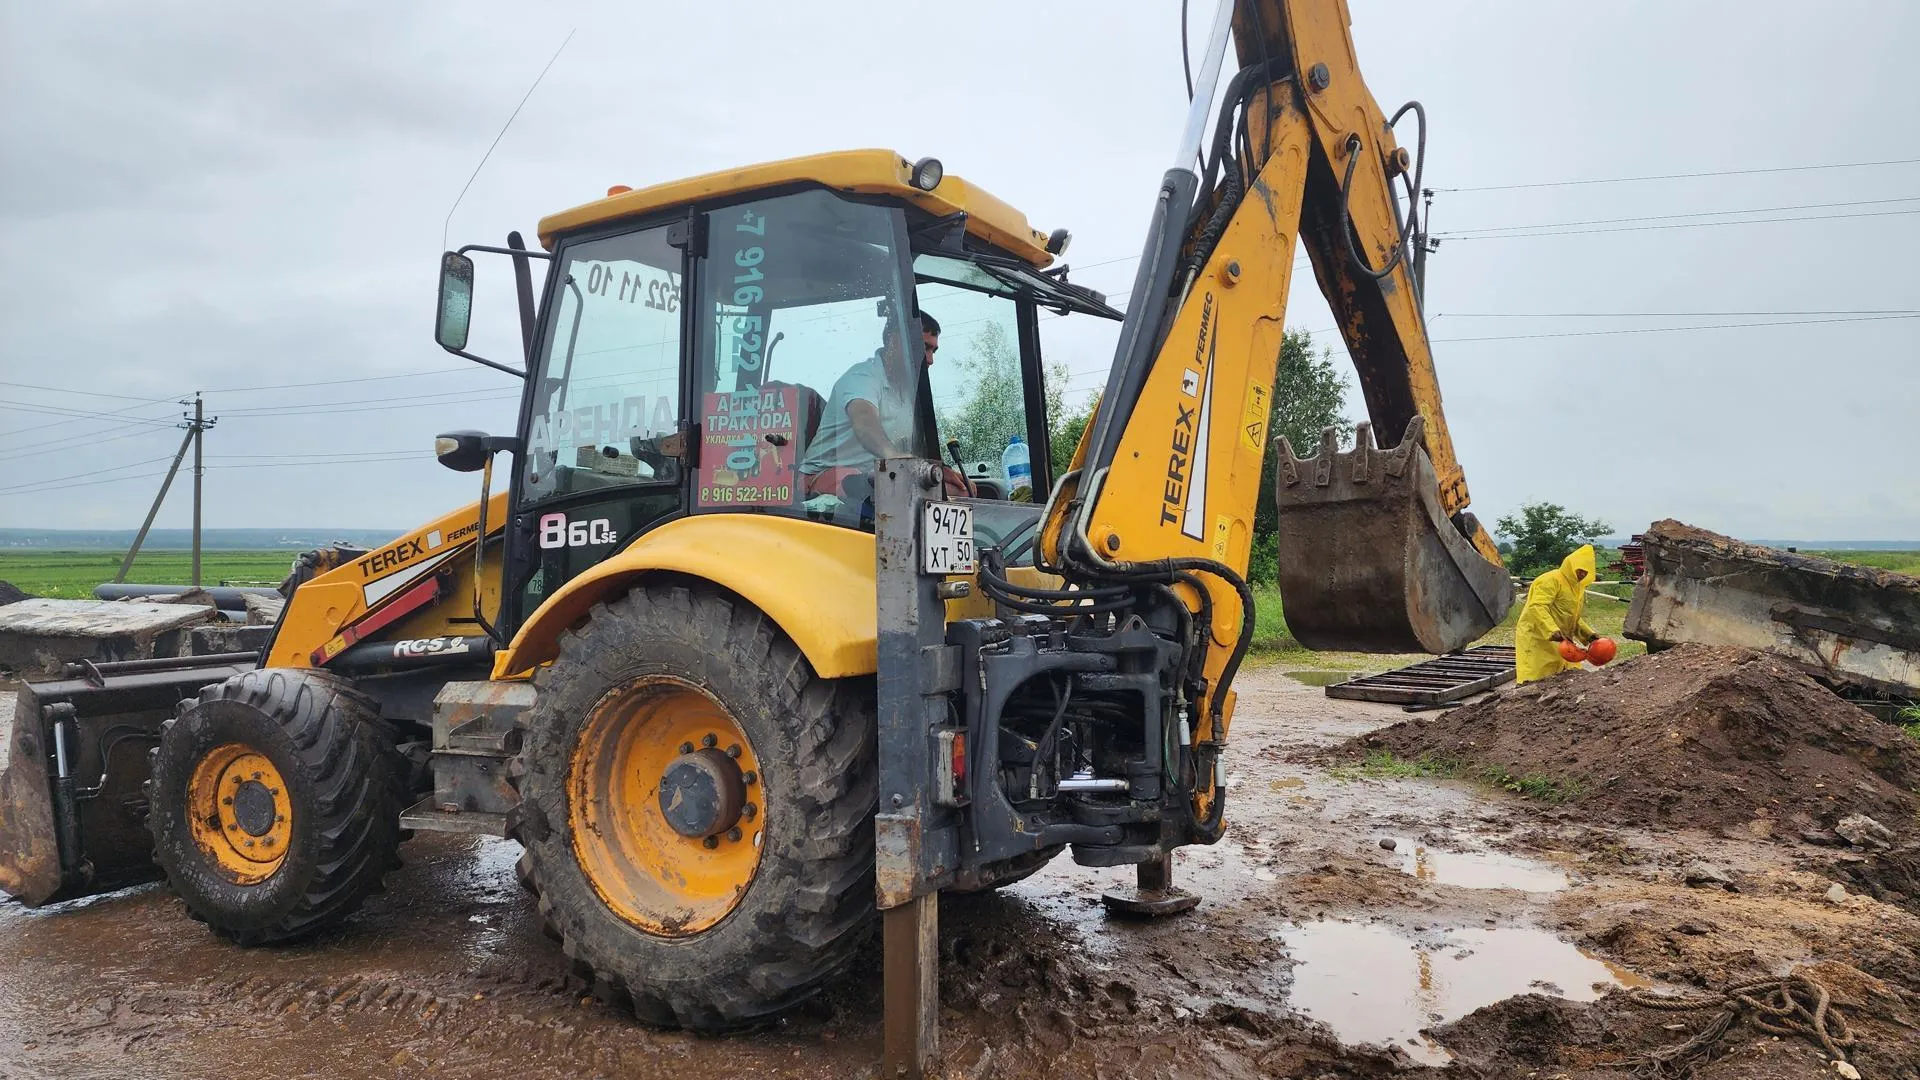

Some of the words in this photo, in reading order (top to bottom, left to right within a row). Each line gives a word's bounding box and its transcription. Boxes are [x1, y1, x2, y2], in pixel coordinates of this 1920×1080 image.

[736, 209, 765, 236] +7
[734, 246, 764, 305] 916
[732, 315, 762, 372] 522
[1196, 291, 1213, 365] FERMEC
[527, 395, 675, 455] АРЕНДА
[707, 412, 792, 432] ТРАКТОРА
[727, 433, 757, 470] 10
[1160, 402, 1196, 527] TEREX
[701, 488, 709, 502] 8
[712, 486, 733, 502] 916
[736, 485, 789, 502] 522-11-10
[447, 521, 482, 543] FERME
[933, 507, 967, 535] 9472
[358, 536, 424, 578] TEREX
[957, 541, 971, 562] 50
